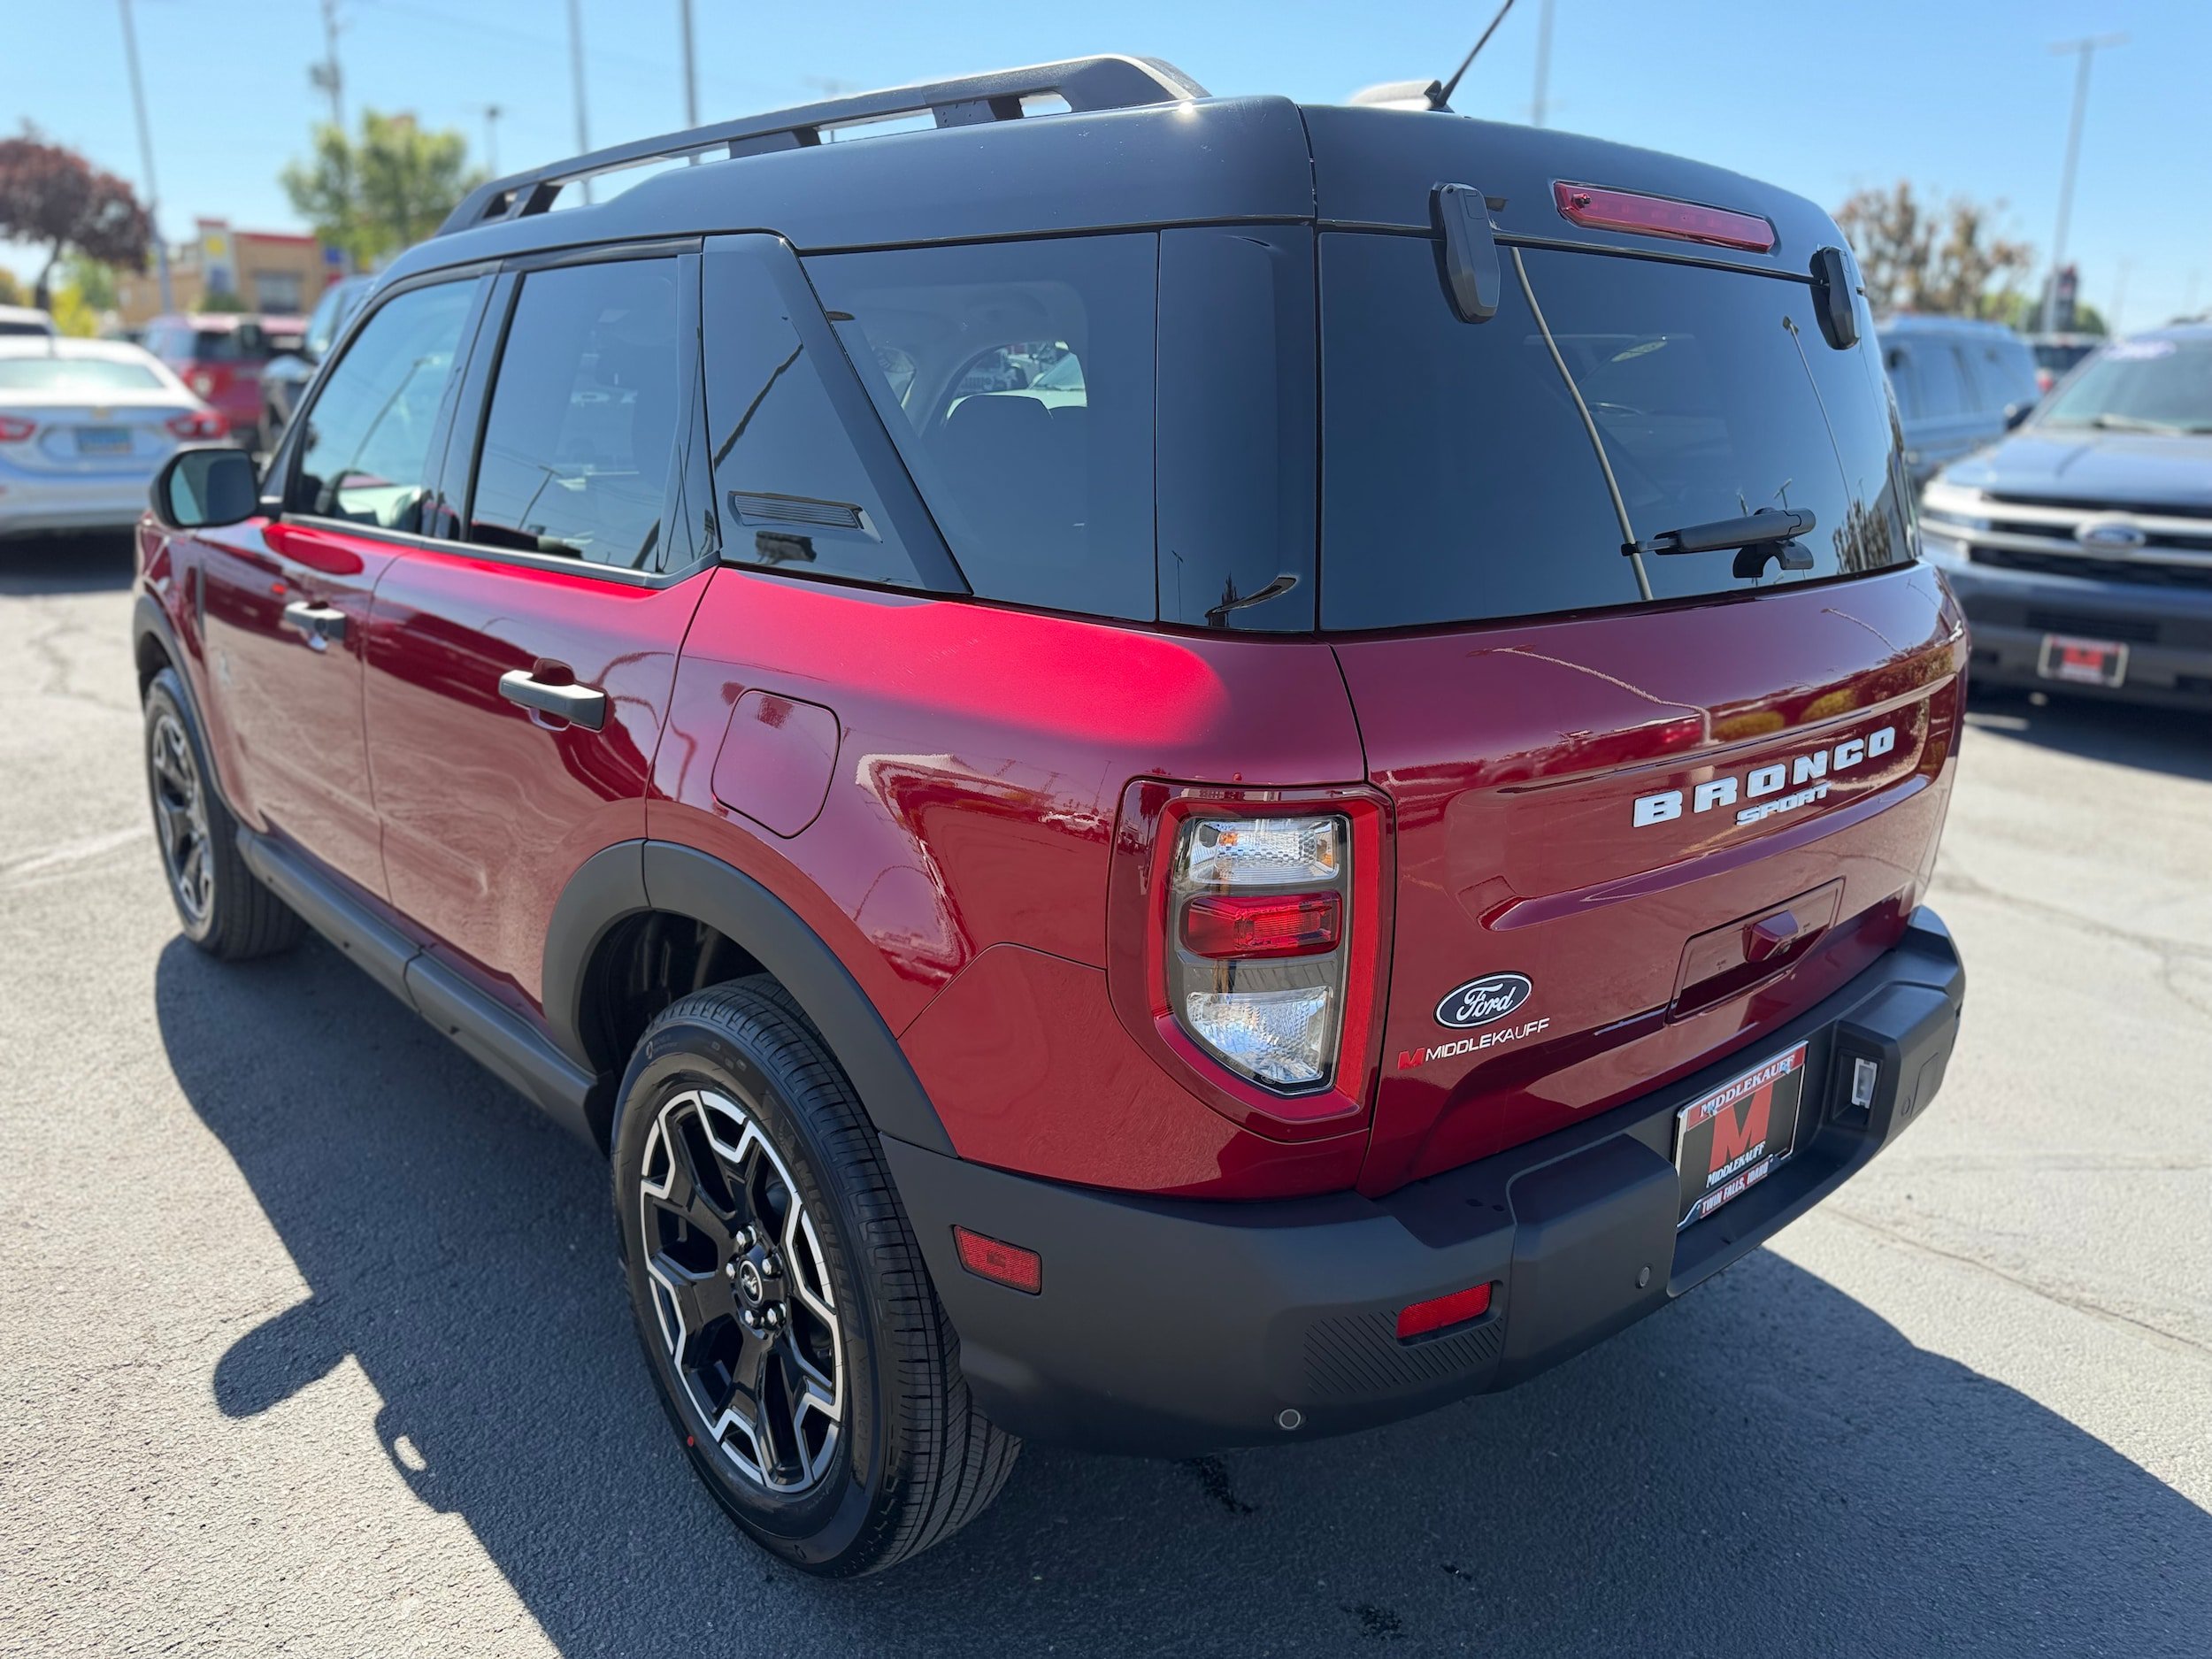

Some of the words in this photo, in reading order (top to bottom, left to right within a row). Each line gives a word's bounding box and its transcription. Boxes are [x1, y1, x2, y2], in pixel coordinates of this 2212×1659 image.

[1632, 726, 1895, 828] BRONCO
[1736, 781, 1832, 826] SPORT
[1455, 982, 1517, 1022] Ford
[1397, 1047, 1425, 1070] M
[1425, 1018, 1550, 1062] MIDDLEKAUFF
[1709, 1081, 1774, 1173] M
[1702, 1190, 1723, 1214] TWIN
[1723, 1177, 1745, 1201] FALLS,
[1747, 1161, 1770, 1185] IDAHO
[1706, 1141, 1766, 1188] MIDDLEKAUFF
